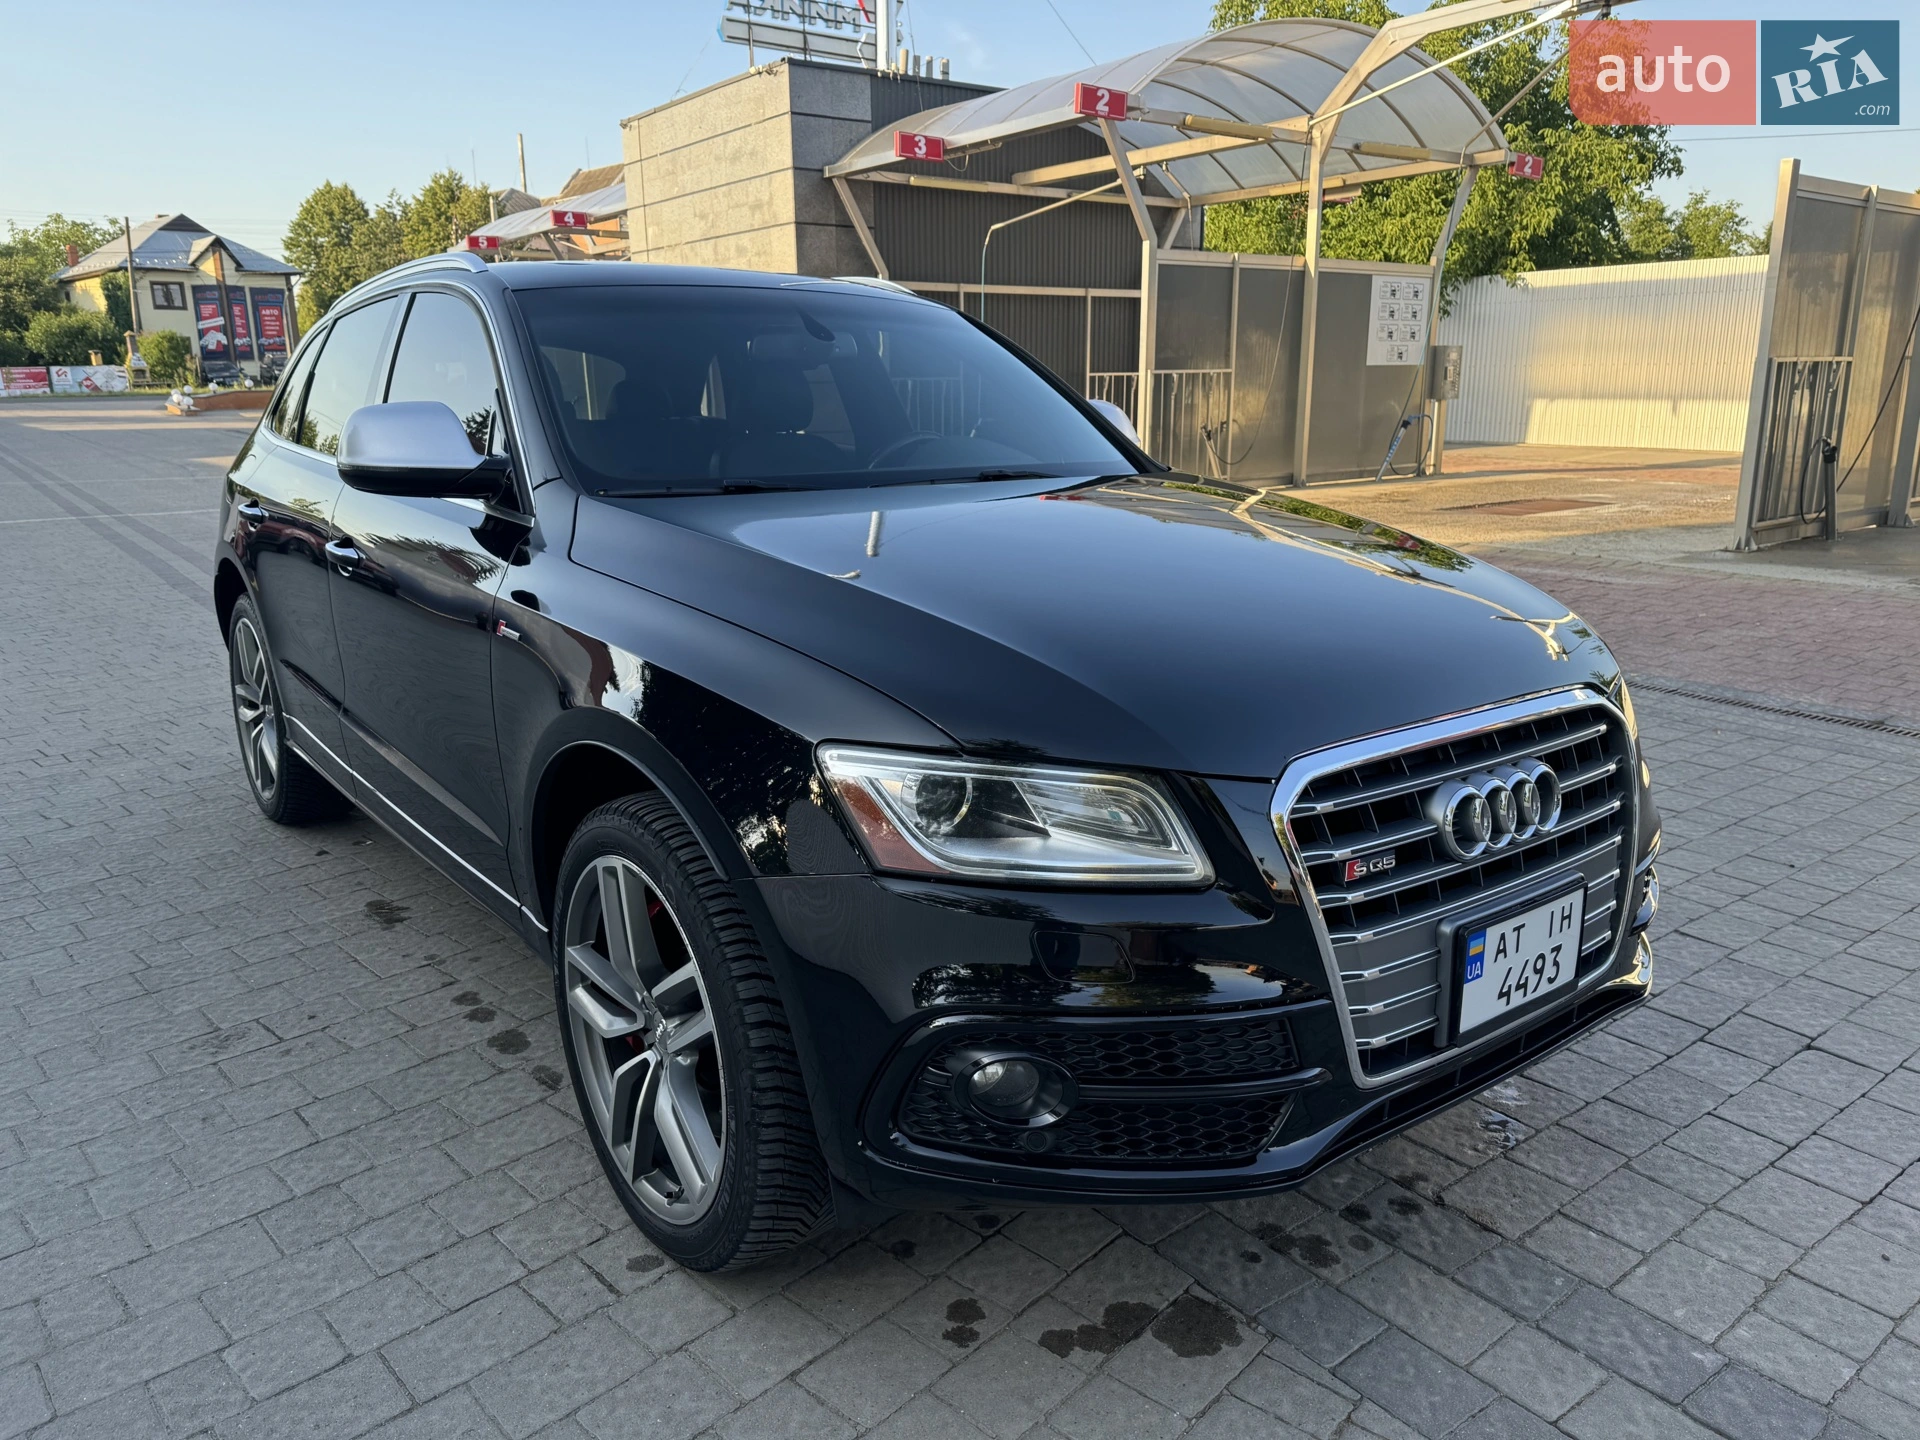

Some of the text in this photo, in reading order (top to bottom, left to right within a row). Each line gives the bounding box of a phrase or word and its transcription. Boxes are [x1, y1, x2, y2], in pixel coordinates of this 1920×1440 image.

[1095, 88, 1110, 112] 2
[914, 135, 927, 155] 3
[1523, 155, 1533, 174] 2
[564, 211, 575, 224] 4
[478, 236, 487, 247] 5
[1494, 901, 1574, 963] AT IH
[1467, 961, 1483, 980] UA
[1497, 943, 1563, 1007] 4493
